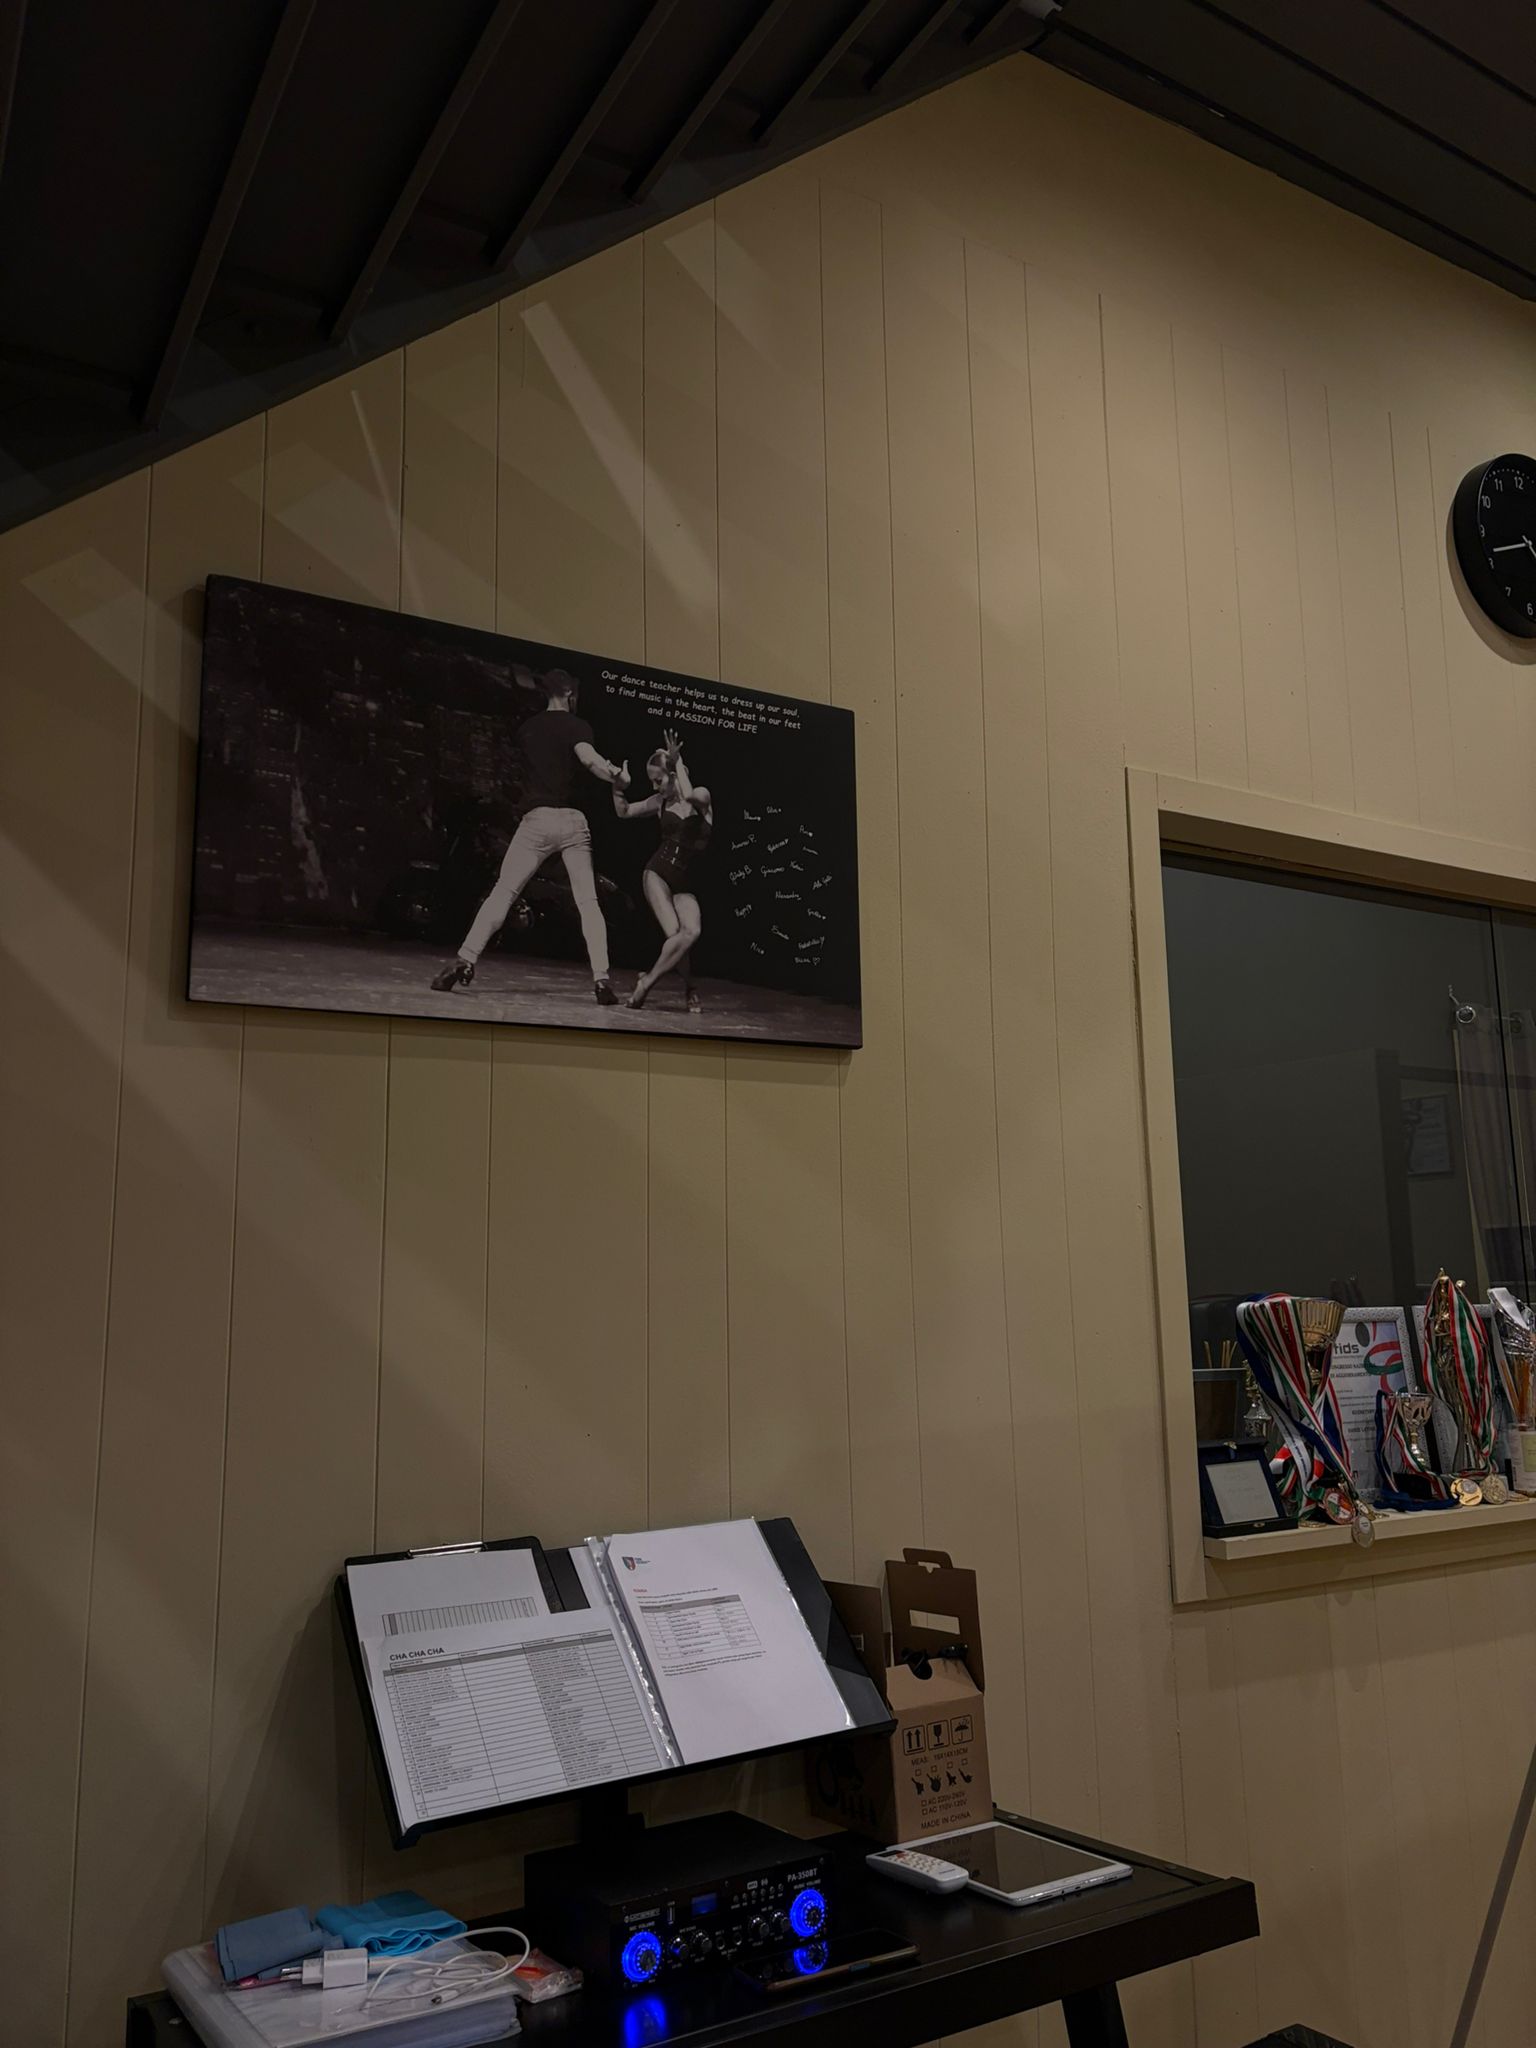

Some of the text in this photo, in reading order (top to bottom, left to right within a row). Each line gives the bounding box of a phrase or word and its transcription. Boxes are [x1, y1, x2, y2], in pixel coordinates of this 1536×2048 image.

[1494, 478, 1503, 492] 11
[1513, 475, 1524, 491] 12
[1481, 495, 1491, 509] 10
[1504, 586, 1512, 598] 7
[1526, 602, 1534, 616] 6
[601, 670, 618, 681] Our
[621, 674, 646, 687] dance
[649, 681, 682, 693] teacher
[684, 686, 705, 699] helps
[708, 693, 717, 701] us
[720, 695, 729, 703] to
[731, 696, 753, 708] dress
[755, 703, 765, 711] up
[767, 705, 781, 713] our
[606, 685, 616, 694] to
[618, 687, 636, 698] find
[638, 693, 662, 703] music
[665, 697, 672, 705] in
[675, 698, 690, 708] the
[721, 707, 735, 717] the
[738, 710, 757, 721] beat
[758, 714, 767, 723] in
[768, 718, 782, 726] our
[784, 718, 801, 730] feet
[647, 707, 664, 716] and
[674, 710, 716, 726] PASSION
[718, 718, 736, 730] FOR
[738, 722, 758, 735] LIFE
[389, 1647, 445, 1661] CHA CHA CHA
[921, 1810, 972, 1829] MADE IN CHINA
